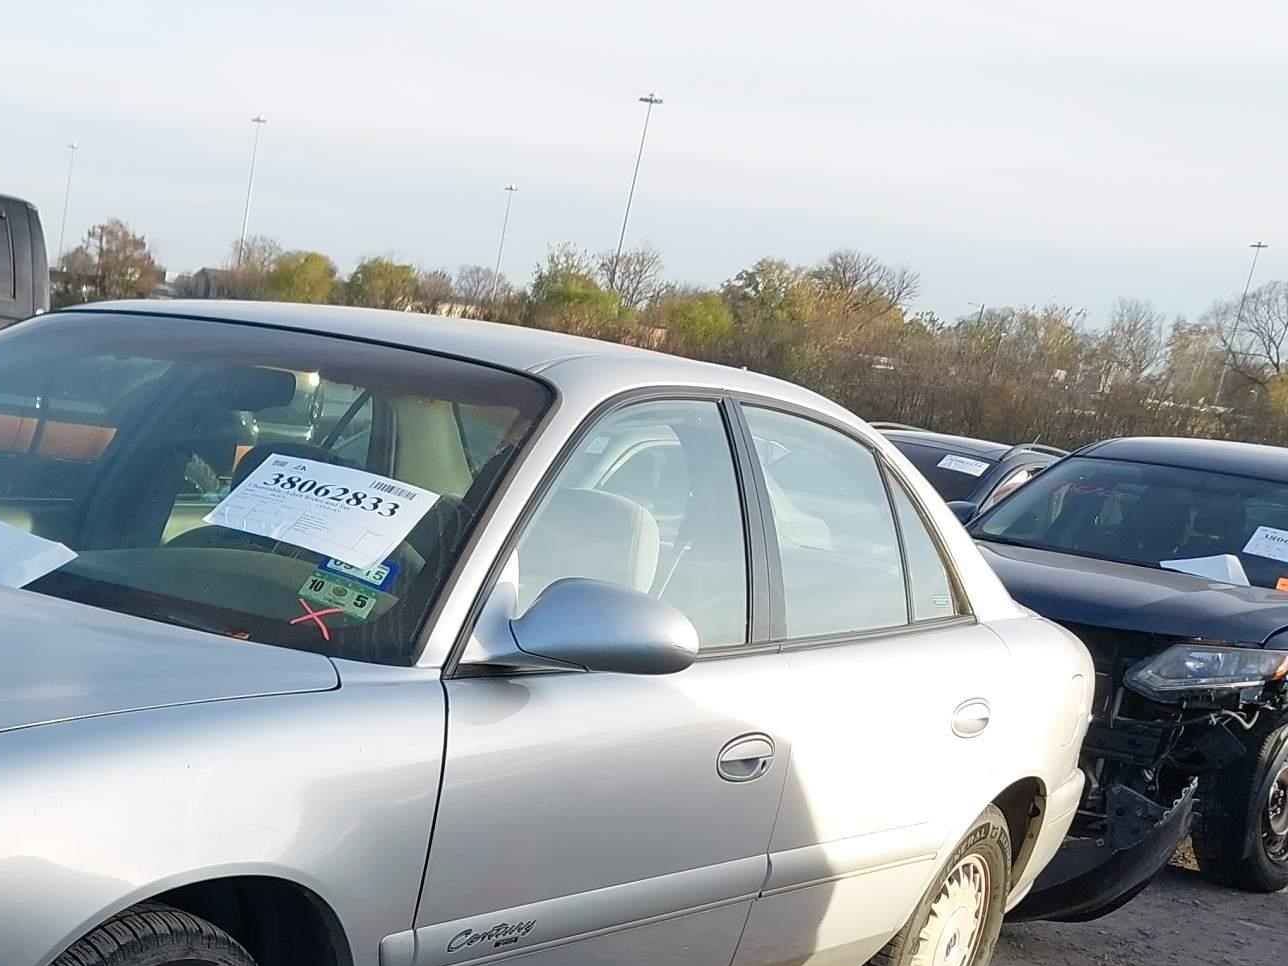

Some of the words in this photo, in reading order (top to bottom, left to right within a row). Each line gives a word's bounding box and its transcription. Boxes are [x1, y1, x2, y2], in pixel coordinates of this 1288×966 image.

[263, 472, 401, 518] 38062833
[308, 577, 325, 592] 10
[352, 594, 369, 609] 5
[447, 920, 537, 953] Century
